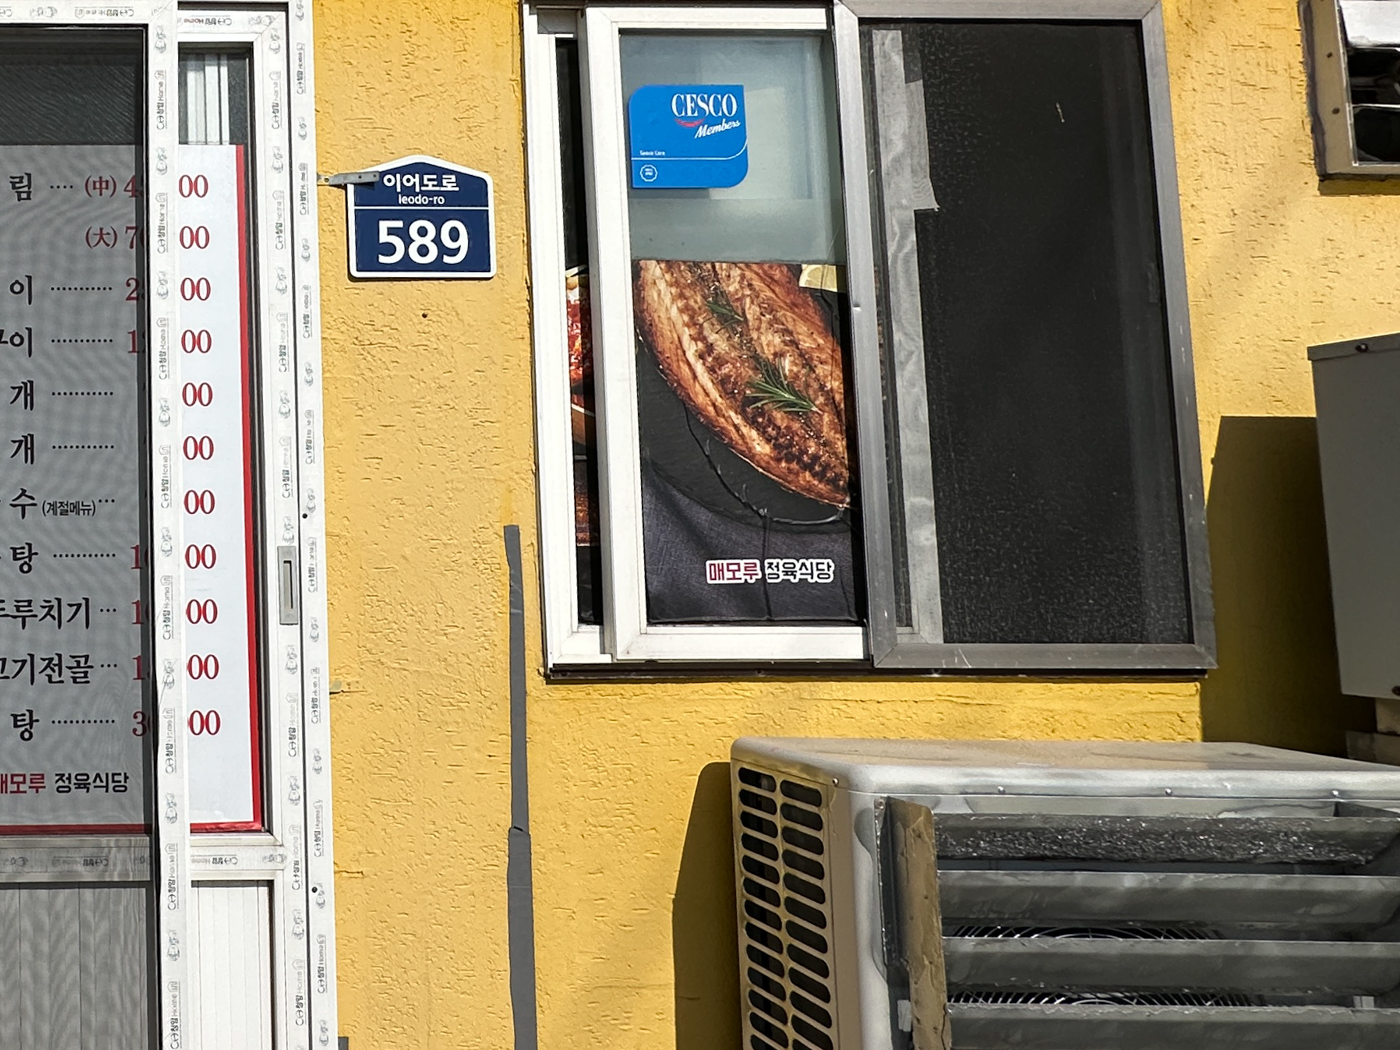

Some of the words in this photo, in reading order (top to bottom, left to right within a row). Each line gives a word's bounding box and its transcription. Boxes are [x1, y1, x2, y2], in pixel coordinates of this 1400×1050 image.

[671, 93, 738, 117] CESCO
[694, 118, 741, 139] Members
[383, 173, 459, 192] 이어도로
[378, 219, 469, 264] 589
[708, 561, 759, 581] 매모루
[766, 561, 832, 580] 정육식당
[54, 771, 129, 793] 정육식당
